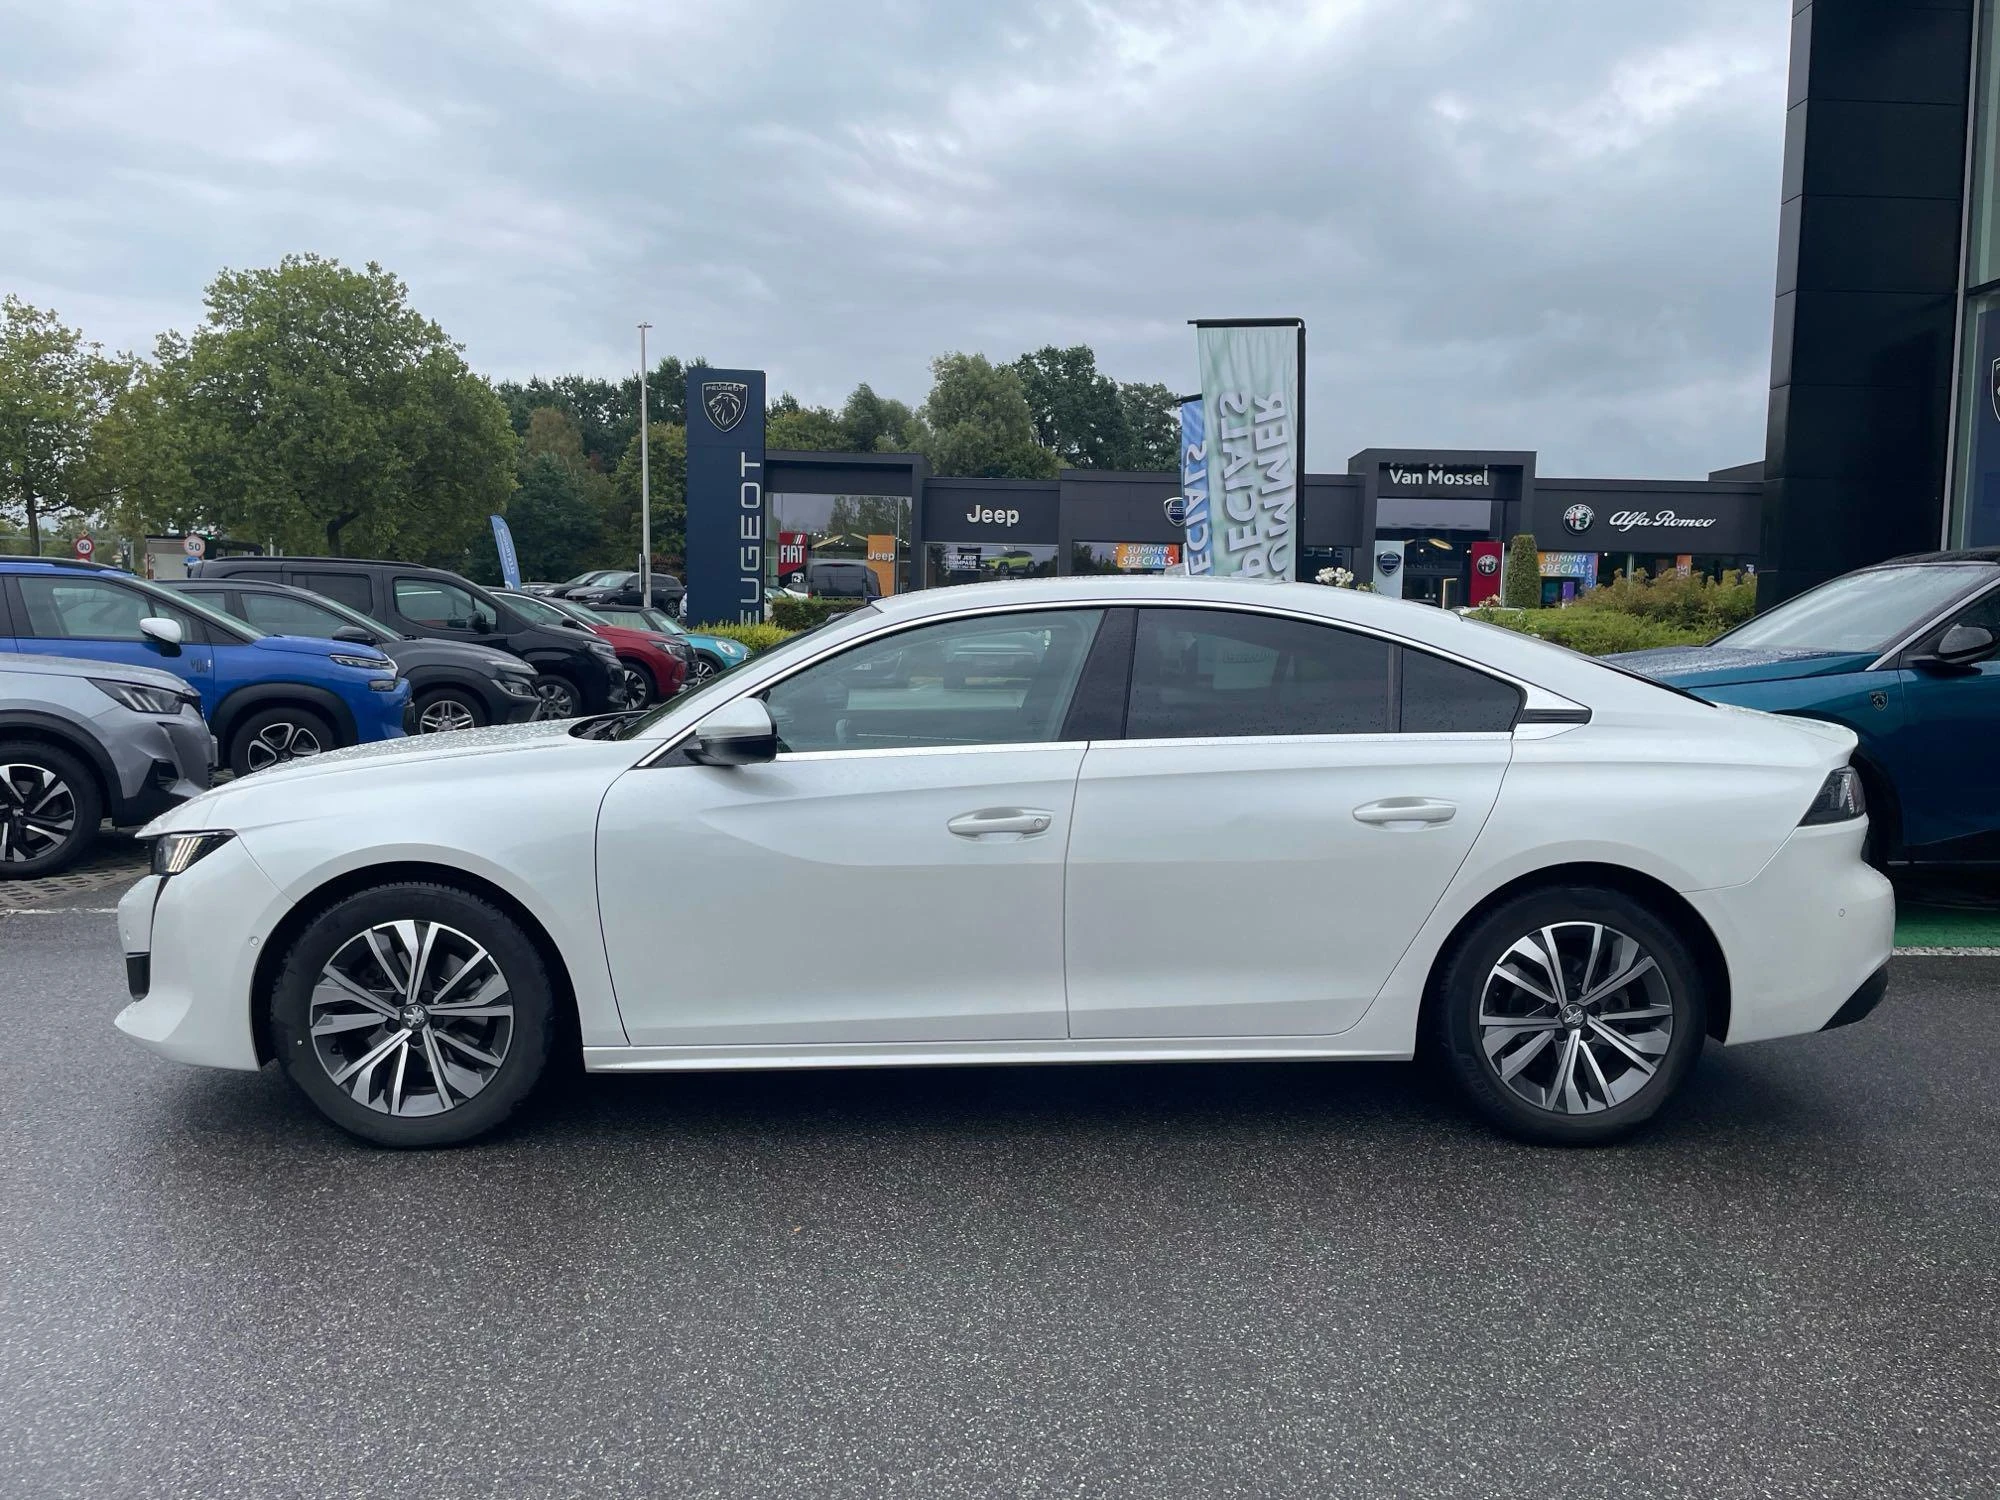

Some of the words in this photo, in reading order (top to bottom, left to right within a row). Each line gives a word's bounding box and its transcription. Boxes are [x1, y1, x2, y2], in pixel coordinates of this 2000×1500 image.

[1389, 469, 1422, 484] Van
[1428, 469, 1489, 486] Mossel
[966, 504, 1020, 527] Jeep
[1608, 510, 1653, 532] Alfa
[1652, 510, 1717, 528] Romeo
[740, 451, 761, 625] EUGEOT
[79, 542, 90, 551] 90
[188, 542, 201, 551] 50
[1127, 546, 1170, 555] SUMMER
[780, 545, 805, 564] FIAT
[867, 550, 895, 563] Jeep
[1122, 556, 1175, 566] SPECIALS
[1539, 563, 1586, 574] SPECIAL
